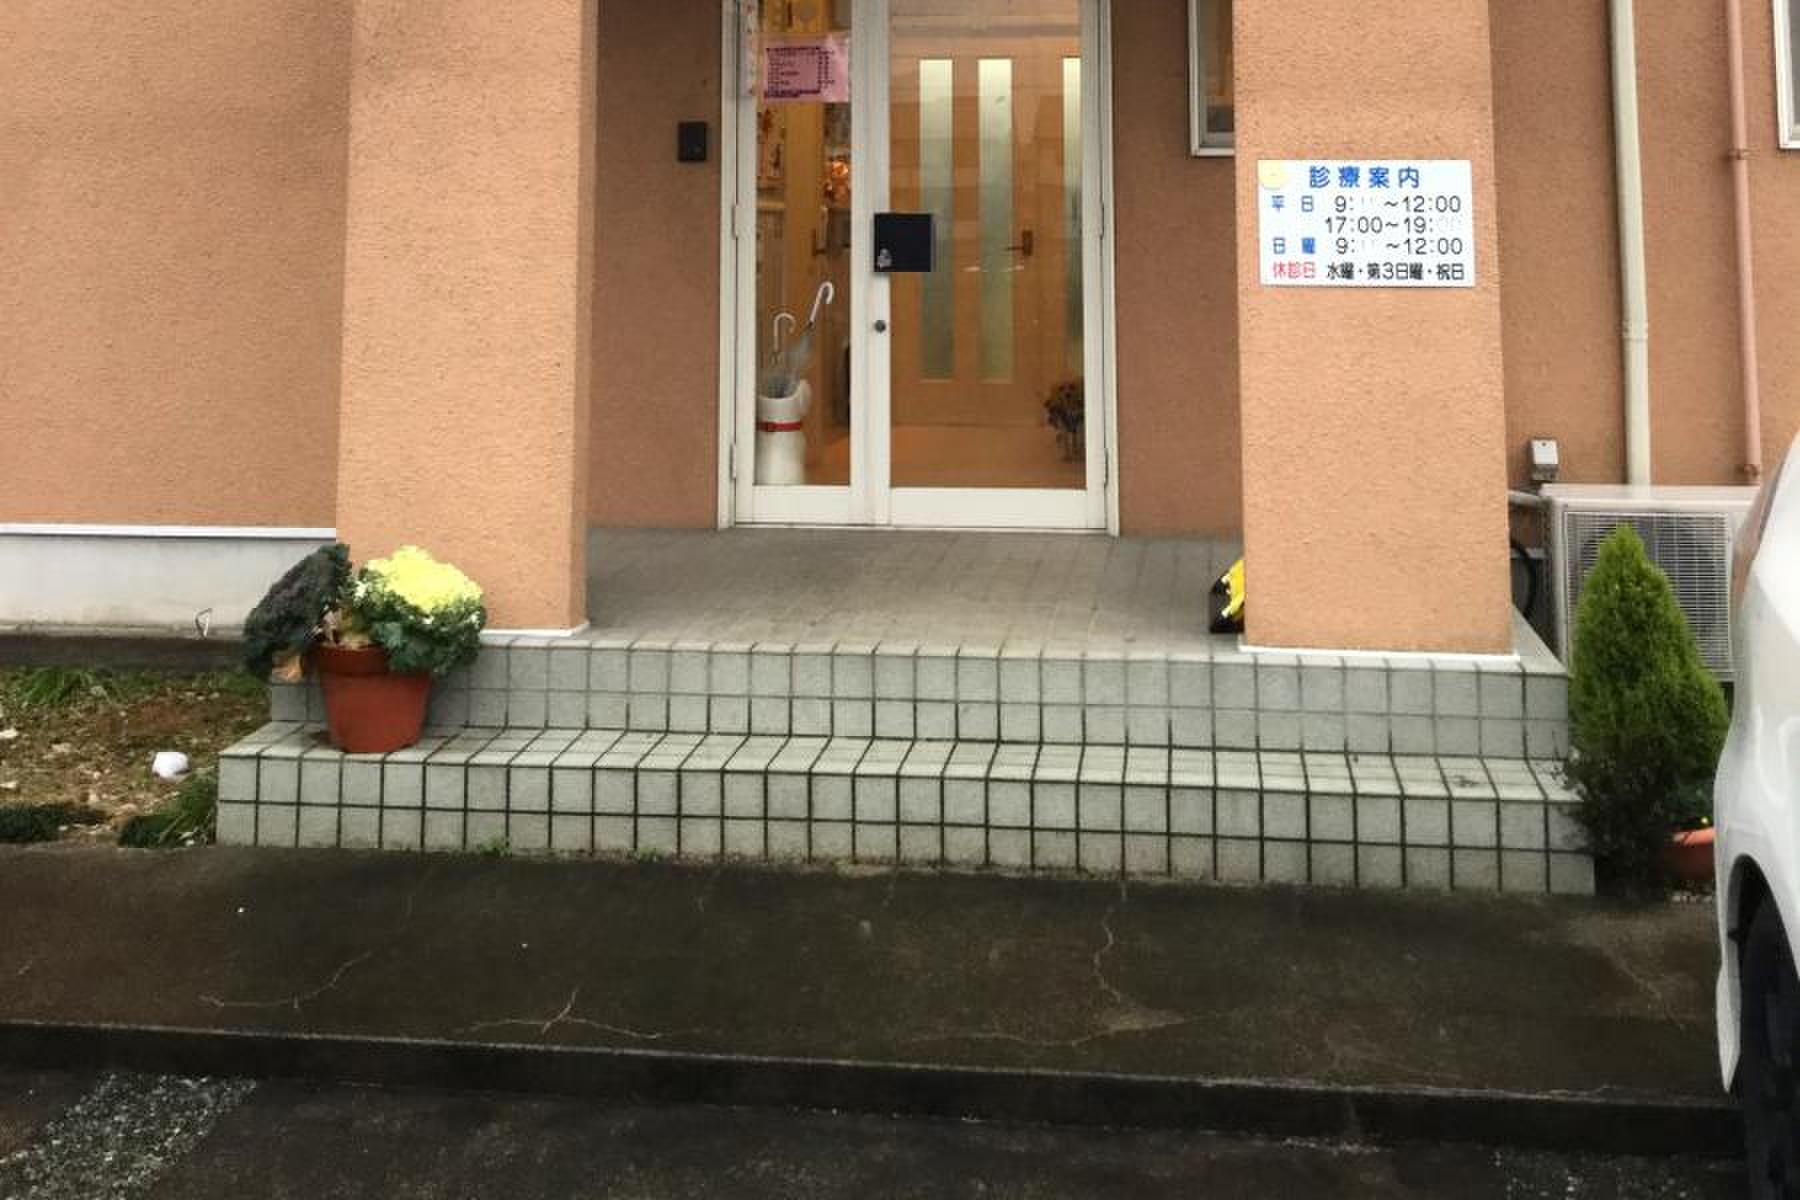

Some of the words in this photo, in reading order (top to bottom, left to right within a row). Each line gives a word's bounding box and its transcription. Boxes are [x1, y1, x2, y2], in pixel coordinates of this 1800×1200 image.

[1309, 165, 1420, 188] 診療案内
[1334, 195, 1461, 213] 9:~12:00
[1325, 216, 1460, 234] 17:00~19:
[1336, 237, 1463, 255] 9:~12:00
